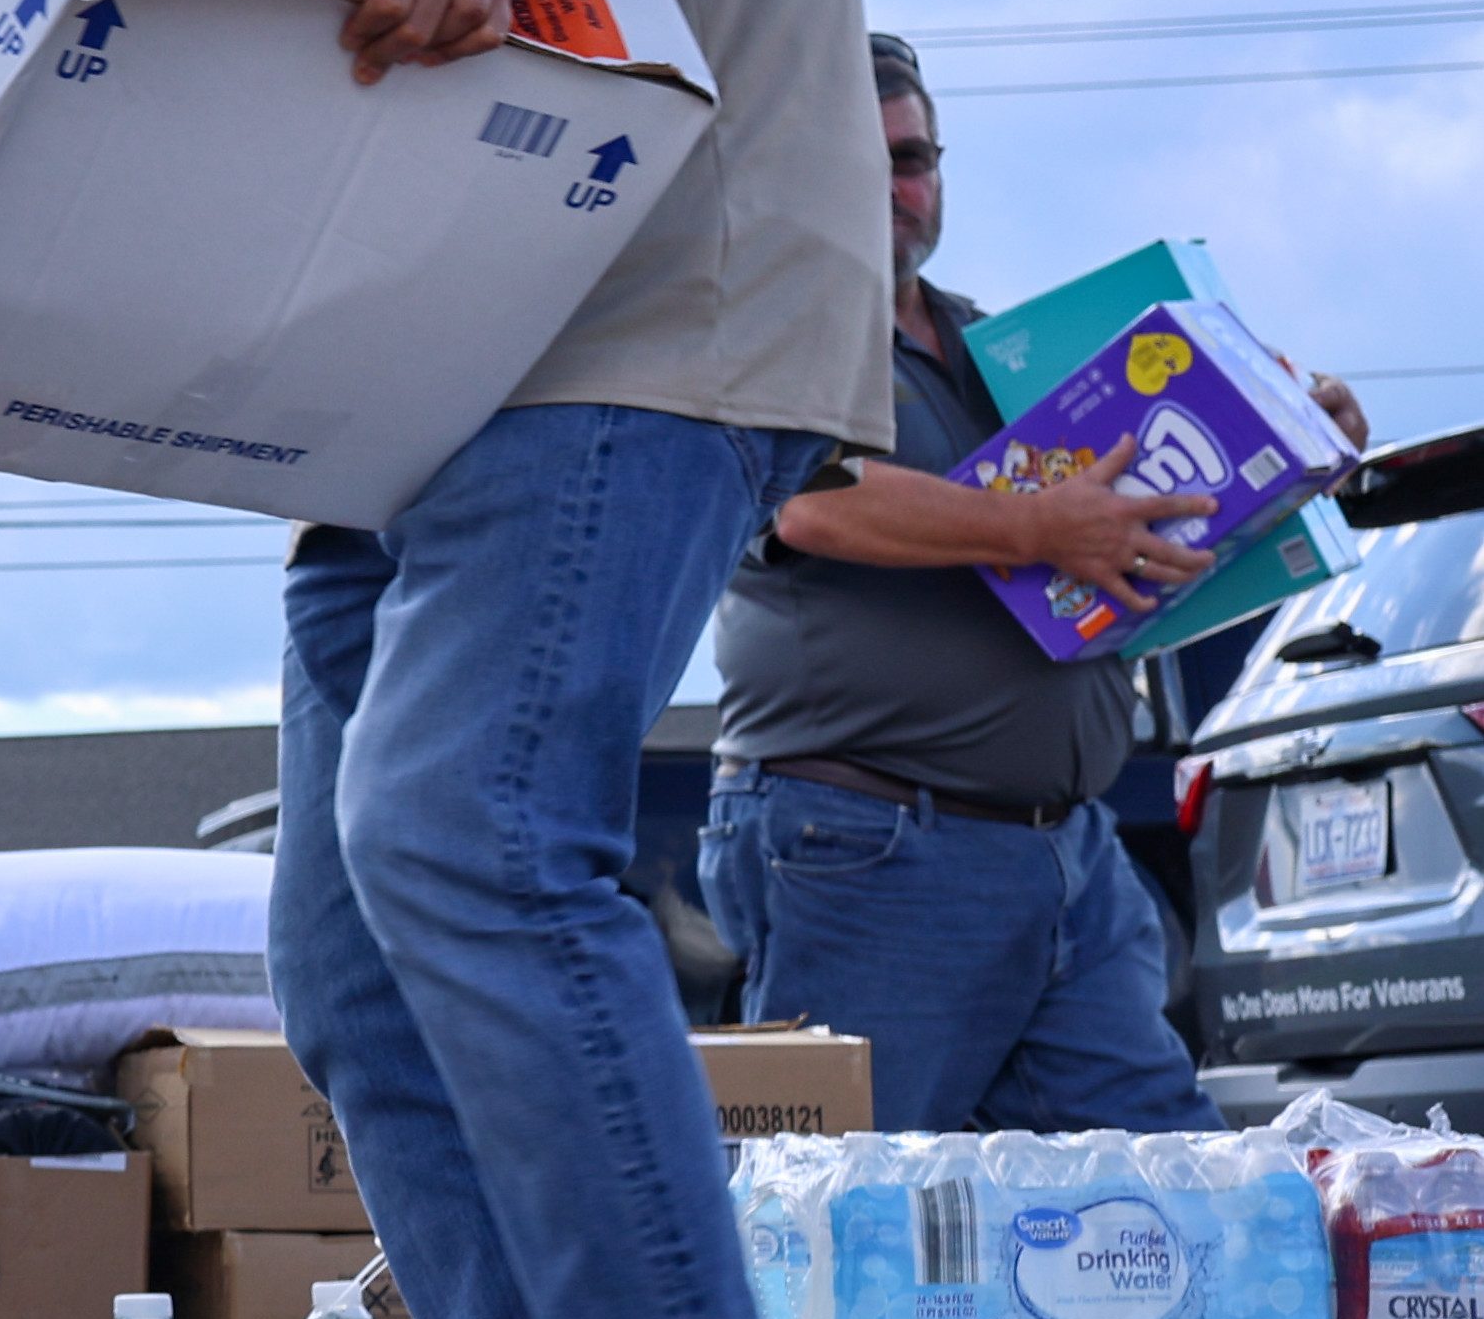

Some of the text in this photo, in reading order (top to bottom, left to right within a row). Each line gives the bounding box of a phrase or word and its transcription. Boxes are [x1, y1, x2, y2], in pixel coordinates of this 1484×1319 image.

[56, 48, 109, 83] UP
[565, 182, 618, 213] UP
[3, 399, 309, 465] PERISHABLE SHIPMENT
[1261, 989, 1298, 1016] Does
[1298, 985, 1339, 1014] More
[1340, 981, 1371, 1011] For
[1372, 976, 1465, 1007] Veterans
[1017, 1215, 1071, 1232] Great
[1077, 1249, 1170, 1273] Drinking
[1109, 1270, 1172, 1290] Water
